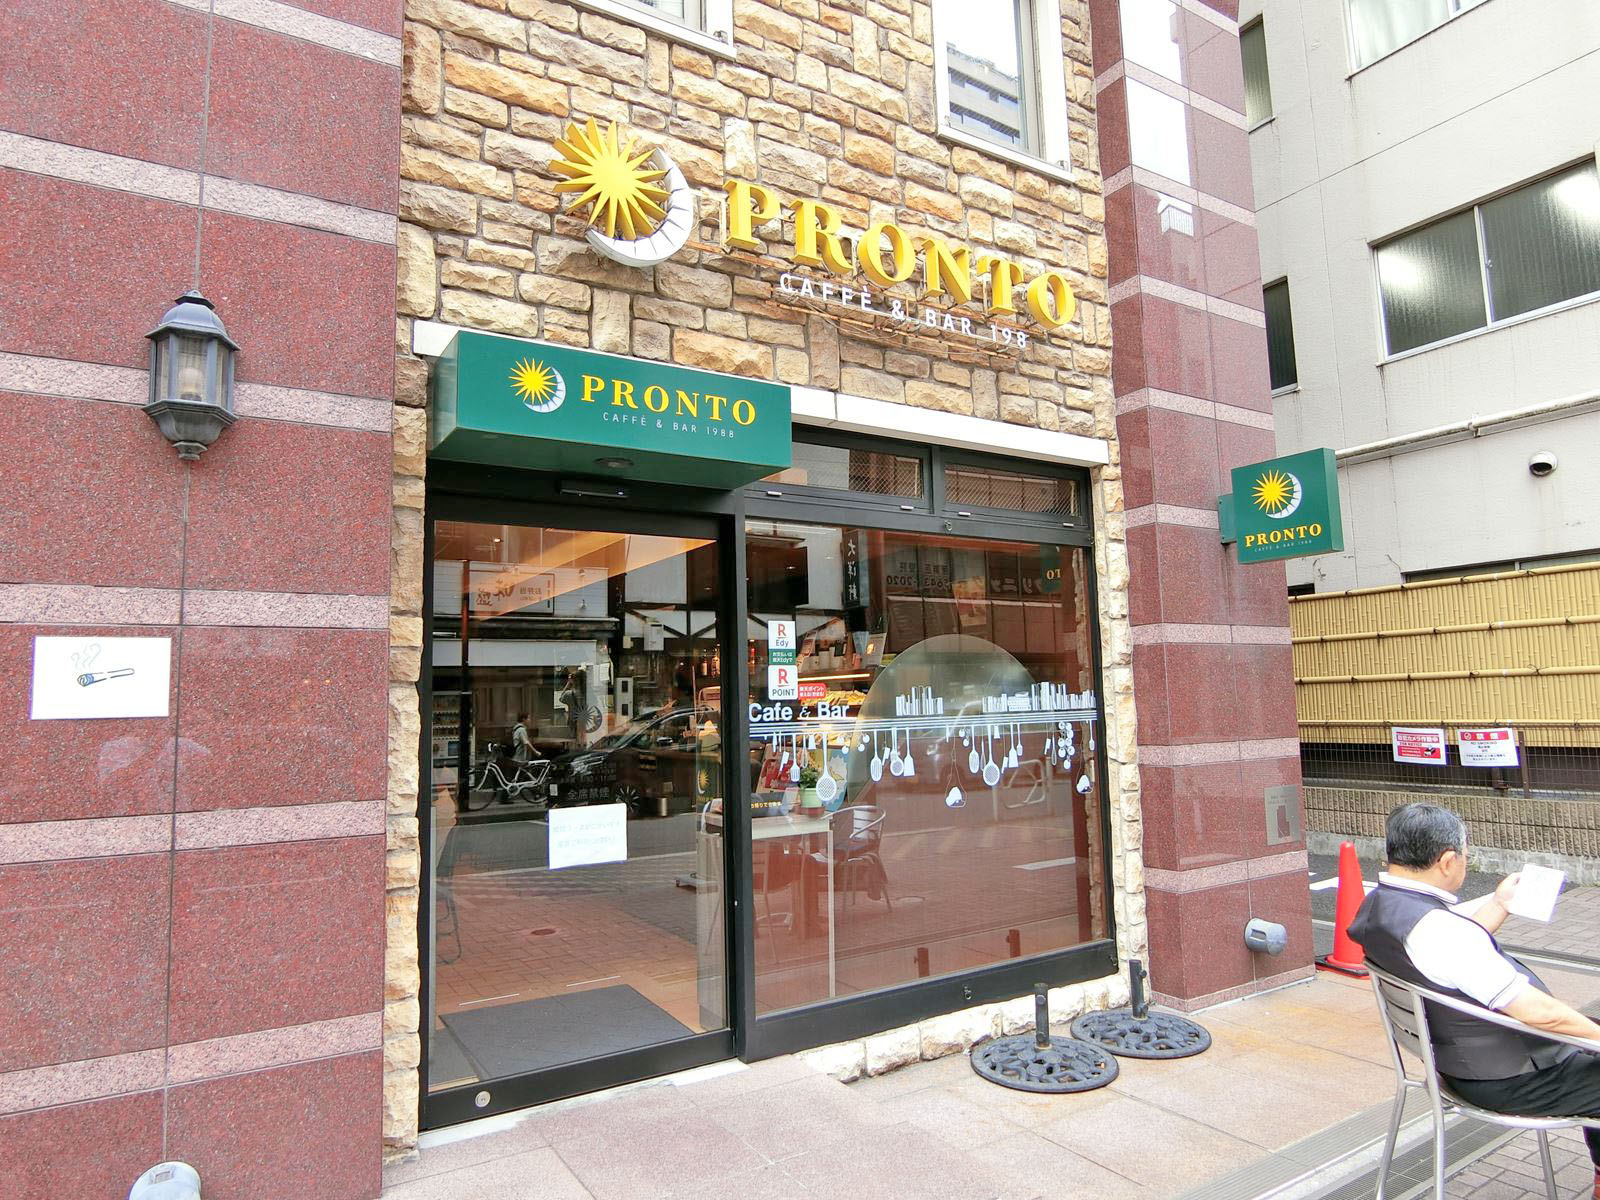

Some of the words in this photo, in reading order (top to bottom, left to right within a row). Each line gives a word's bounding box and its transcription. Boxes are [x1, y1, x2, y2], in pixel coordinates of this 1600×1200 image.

[722, 179, 1075, 329] PRONTO
[780, 273, 872, 311] CAFFÈ
[892, 299, 904, 320] &
[925, 309, 972, 336] BAR
[991, 324, 1027, 348] 198
[581, 374, 756, 426] PRONTO
[603, 411, 647, 426] CAFFÈ
[656, 419, 663, 429] &
[673, 421, 697, 433] BAR
[706, 426, 734, 438] 1988
[1245, 523, 1322, 547] PRONTO
[775, 639, 790, 648] Edy
[772, 688, 795, 697] POINT
[748, 702, 793, 722] Cafe
[799, 706, 811, 718] &
[817, 701, 850, 719] Bar
